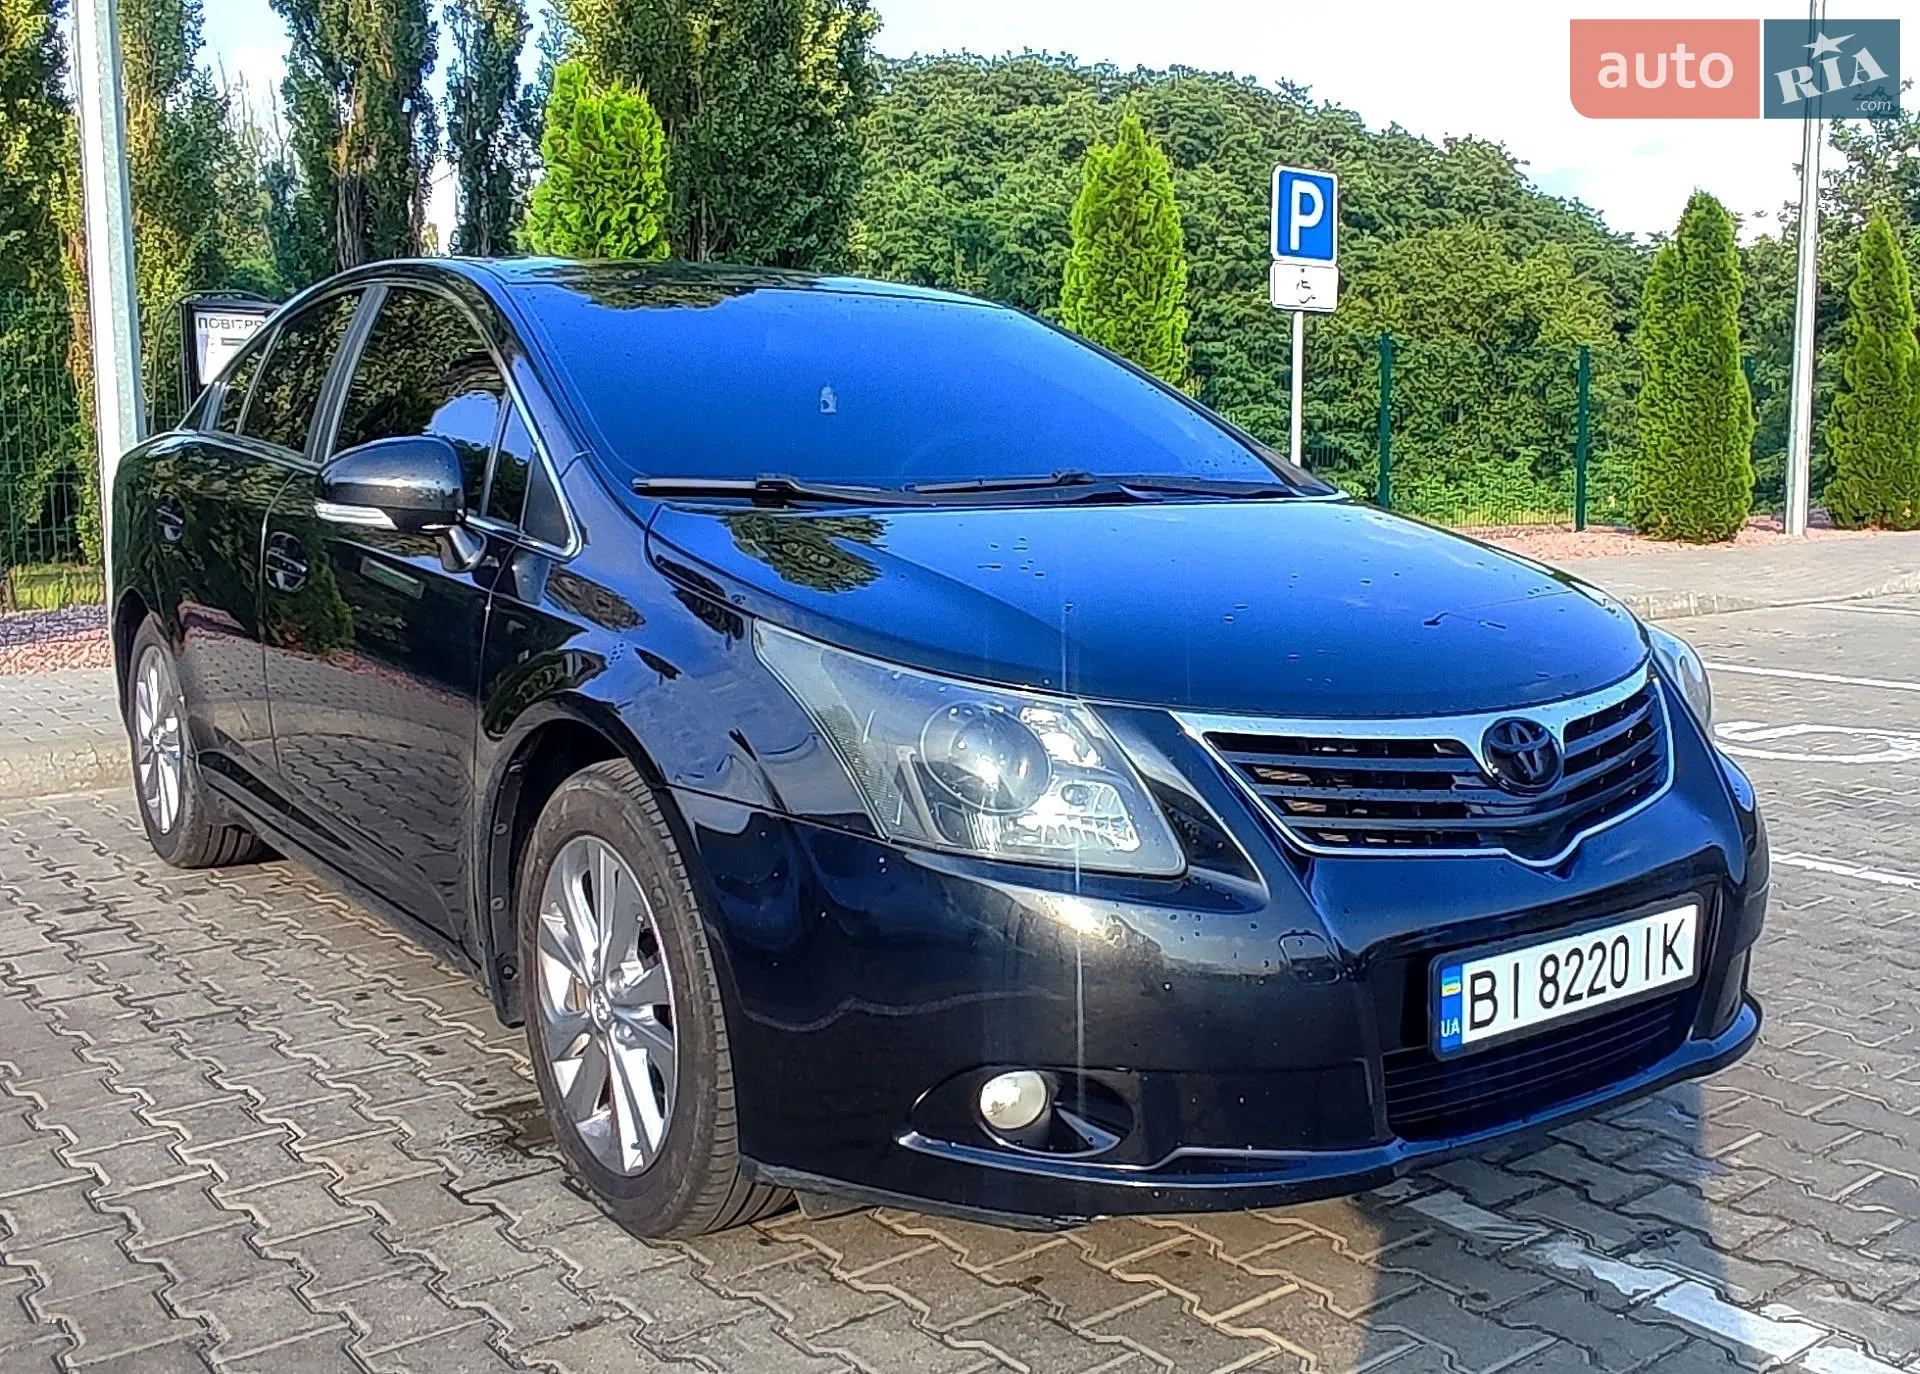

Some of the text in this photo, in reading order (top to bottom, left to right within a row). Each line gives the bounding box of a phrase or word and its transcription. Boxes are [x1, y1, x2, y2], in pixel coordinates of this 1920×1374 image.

[1290, 179, 1325, 251] P
[1469, 918, 1686, 1032] BI 8220 IK
[1440, 1018, 1461, 1038] UA
